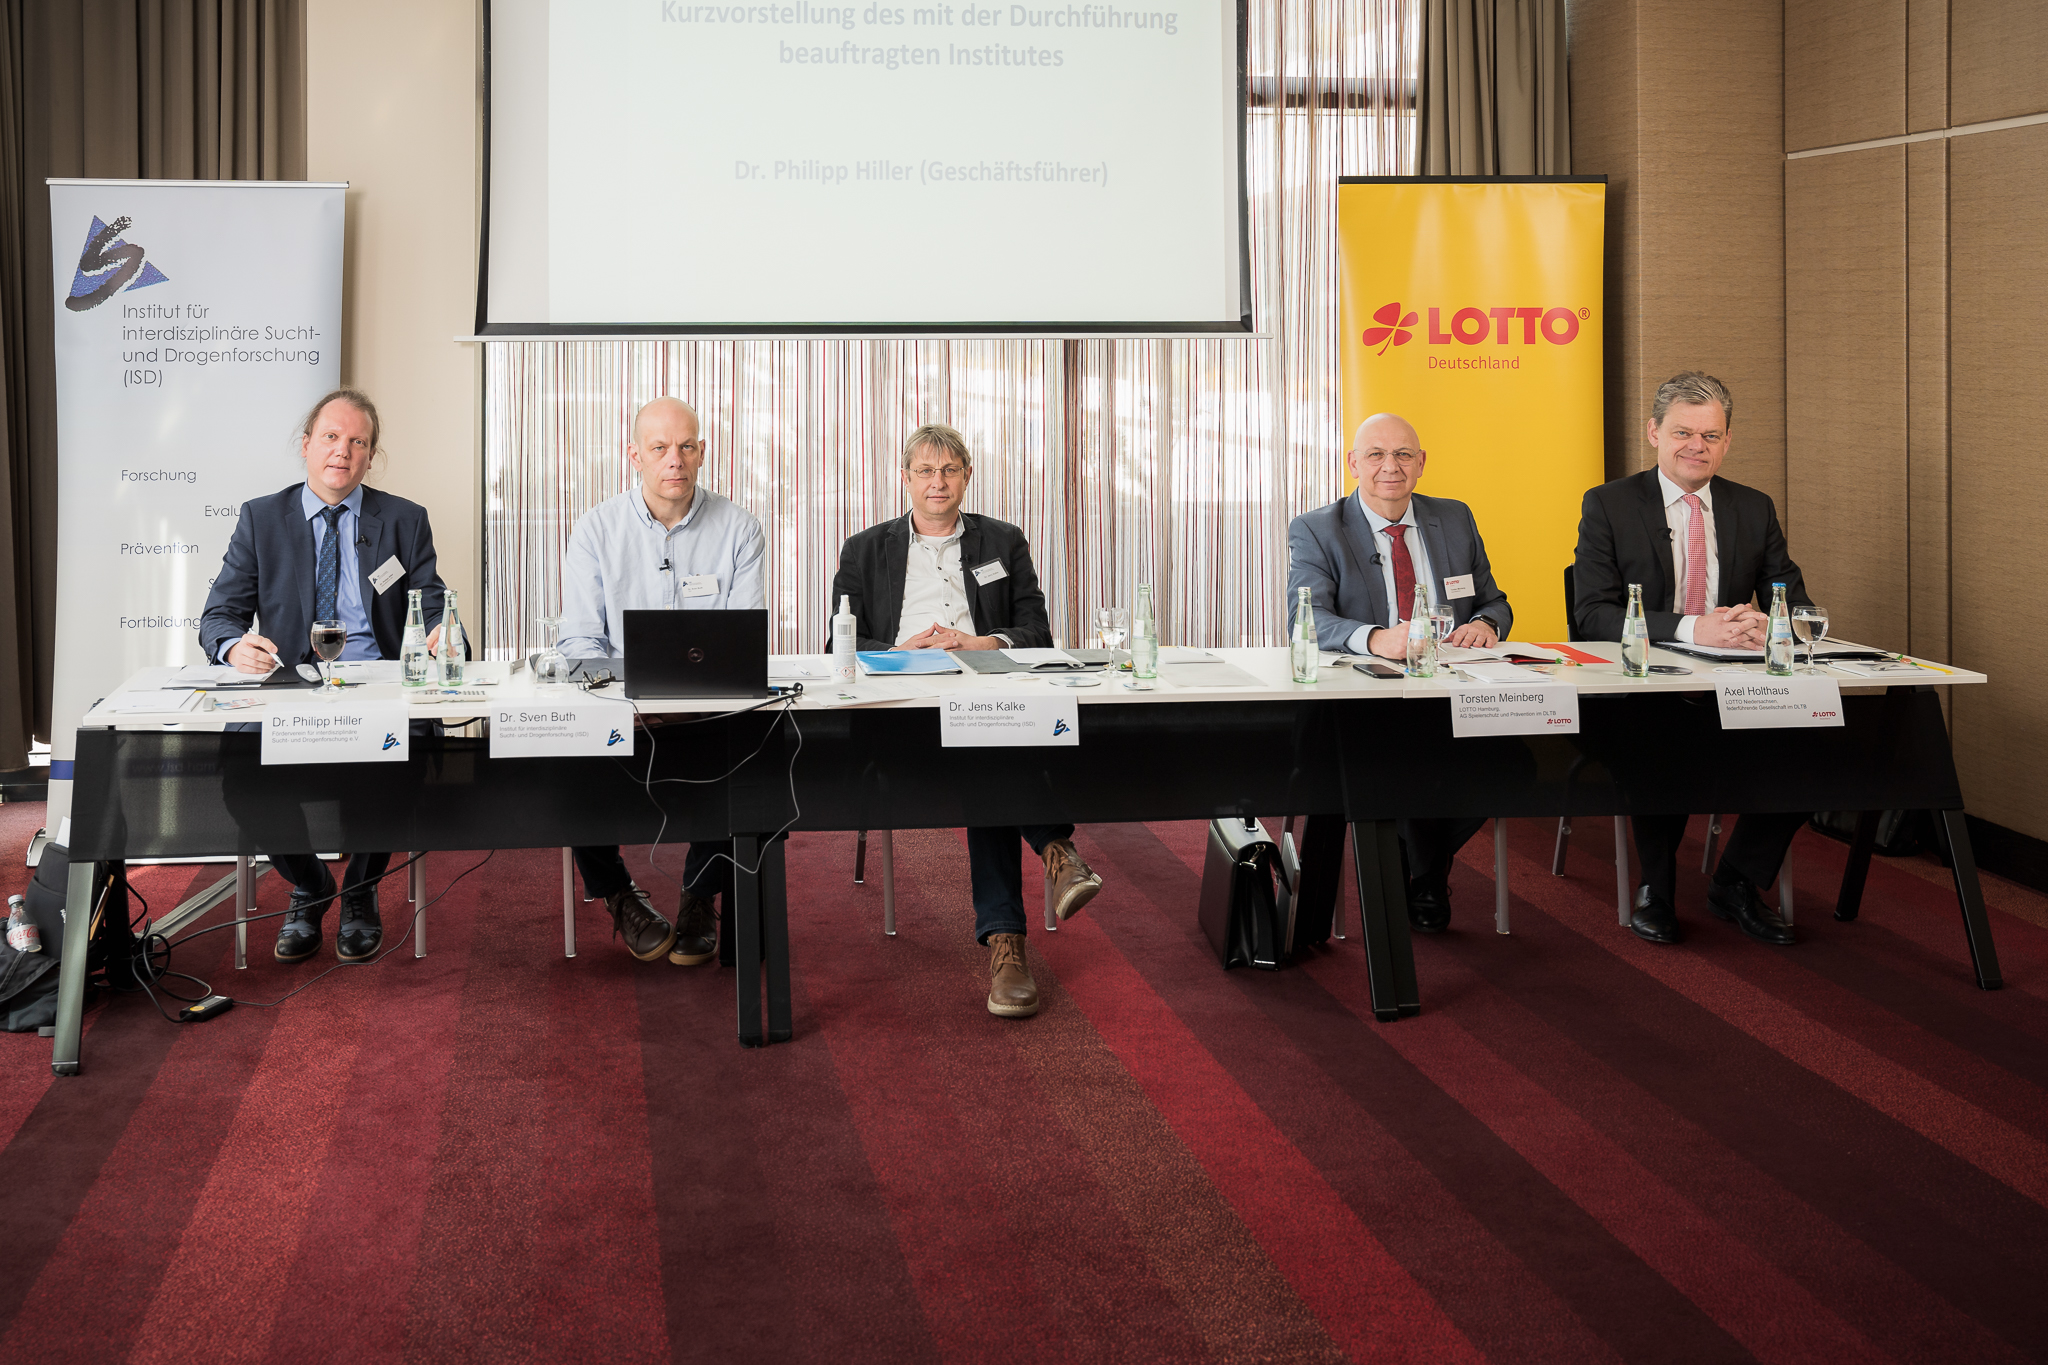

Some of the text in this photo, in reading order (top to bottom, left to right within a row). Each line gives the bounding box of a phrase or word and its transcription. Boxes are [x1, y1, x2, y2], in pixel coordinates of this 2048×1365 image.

[661, 0, 1178, 35] Kurzvorstellung des mit der Durchführung
[780, 40, 1064, 70] beauftragten Institutes
[735, 160, 1108, 188] Dr. Philipp Hiller (Geschäftsführer)
[123, 304, 210, 319] Institut für
[122, 326, 321, 343] interdisziplinäre Sucht-
[122, 348, 320, 365] und Drogenforschung
[1428, 356, 1520, 369] Deutschland
[123, 370, 163, 387] (ISD)
[122, 470, 196, 483] Forschung
[204, 505, 241, 516] Evalu
[121, 542, 199, 554] Prävention
[120, 616, 201, 630] Fortbildung
[1724, 686, 1789, 696] Axel Holthaus
[1459, 693, 1544, 703] Torsten Meinberg
[949, 702, 1026, 712] Dr. Jens Kalke
[272, 716, 362, 728] Dr. Philipp Hiller
[500, 712, 576, 722] Dr. Sven Buth
